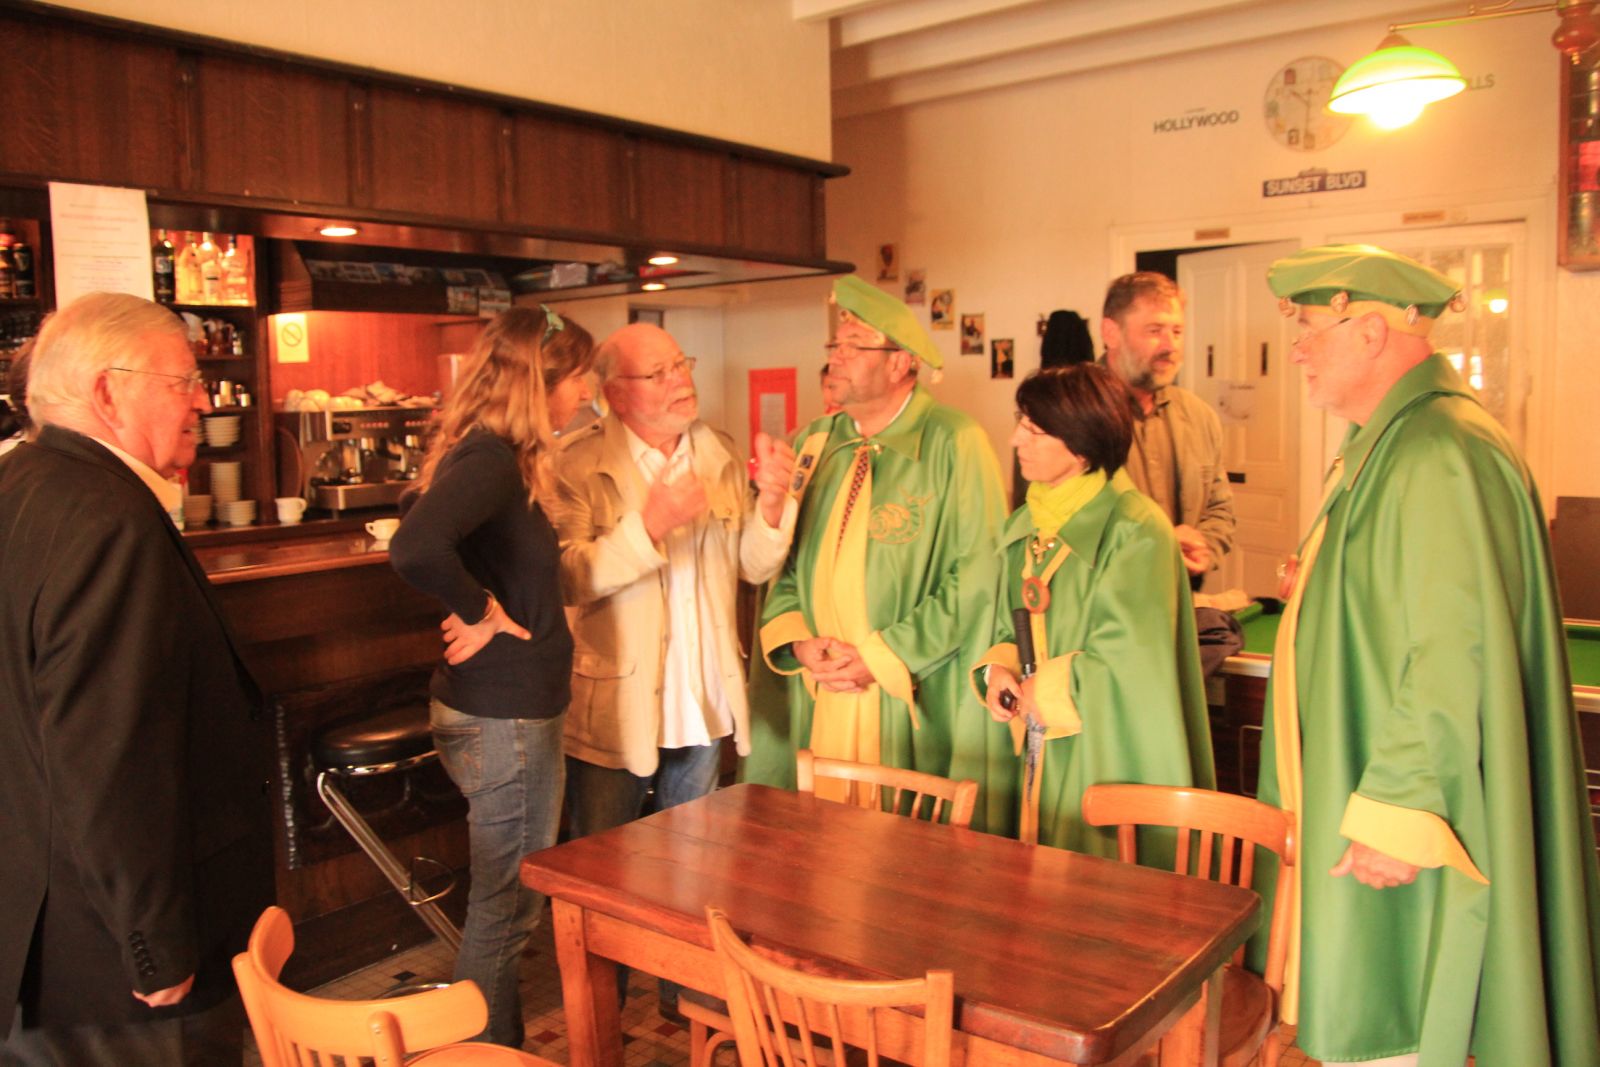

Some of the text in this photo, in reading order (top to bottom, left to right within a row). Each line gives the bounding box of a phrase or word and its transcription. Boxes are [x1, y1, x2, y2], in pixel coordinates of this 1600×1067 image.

[1153, 109, 1239, 134] HOLLYWOOD
[1266, 175, 1321, 196] SUNSET
[1325, 172, 1362, 190] BLVD
